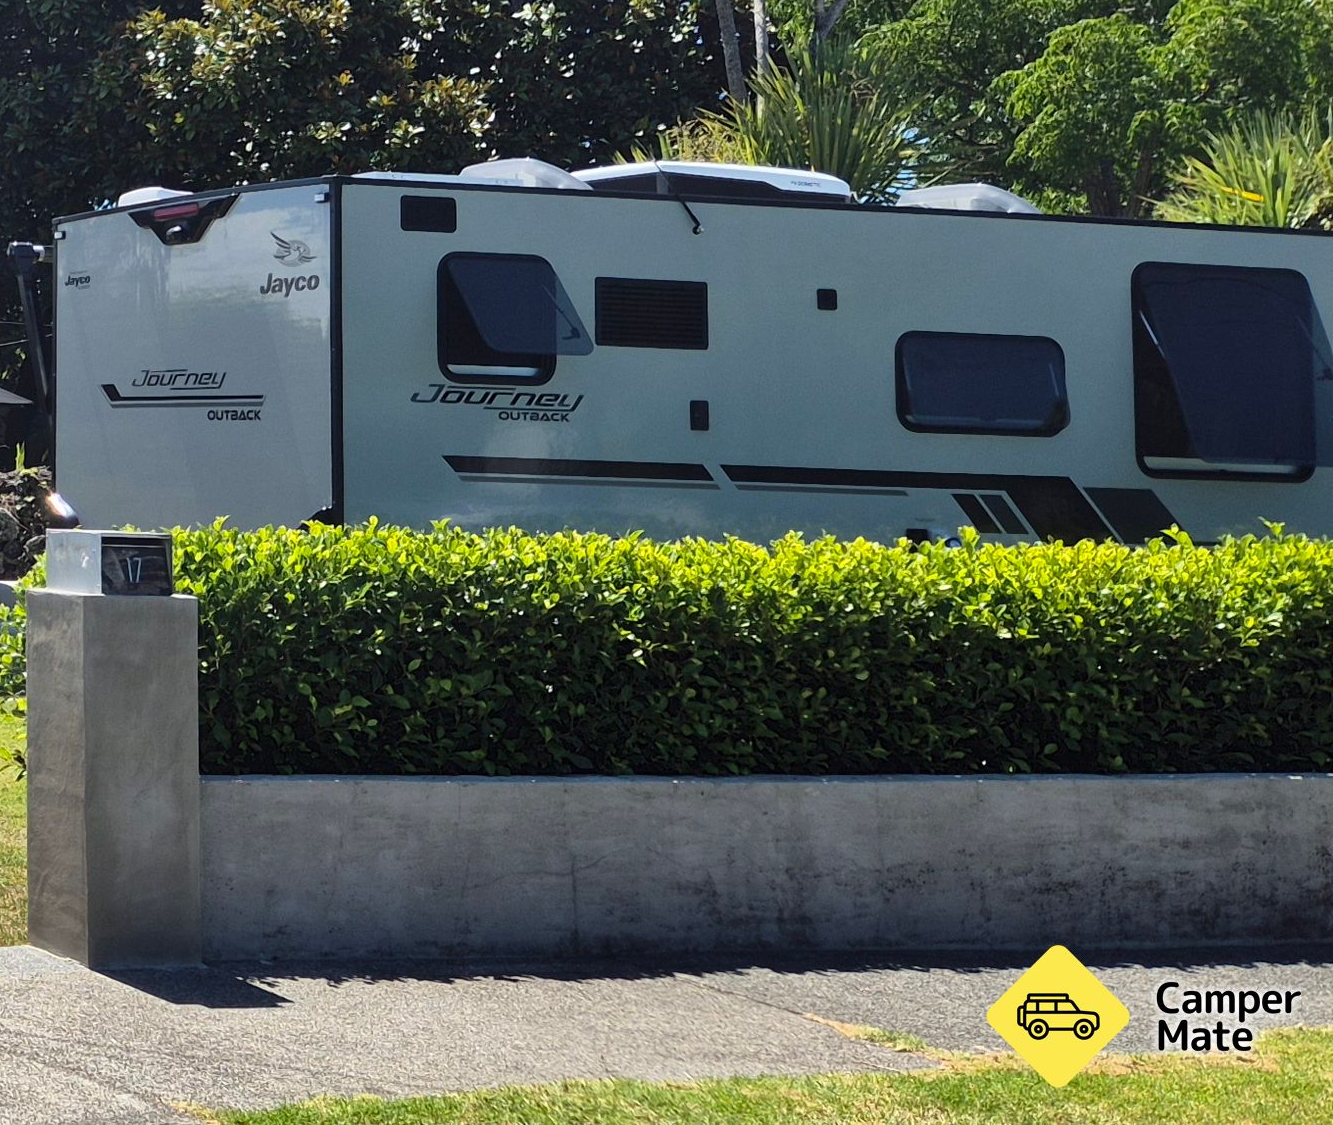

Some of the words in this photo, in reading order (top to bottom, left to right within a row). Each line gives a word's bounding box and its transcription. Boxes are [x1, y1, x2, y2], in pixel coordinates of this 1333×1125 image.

[64, 275, 91, 287] Jayco
[260, 273, 320, 297] Jayco
[132, 369, 227, 390] Journey
[410, 384, 584, 412] Journey
[207, 409, 261, 421] OUTBACK
[498, 411, 570, 422] OUTBACK
[126, 557, 142, 584] 17
